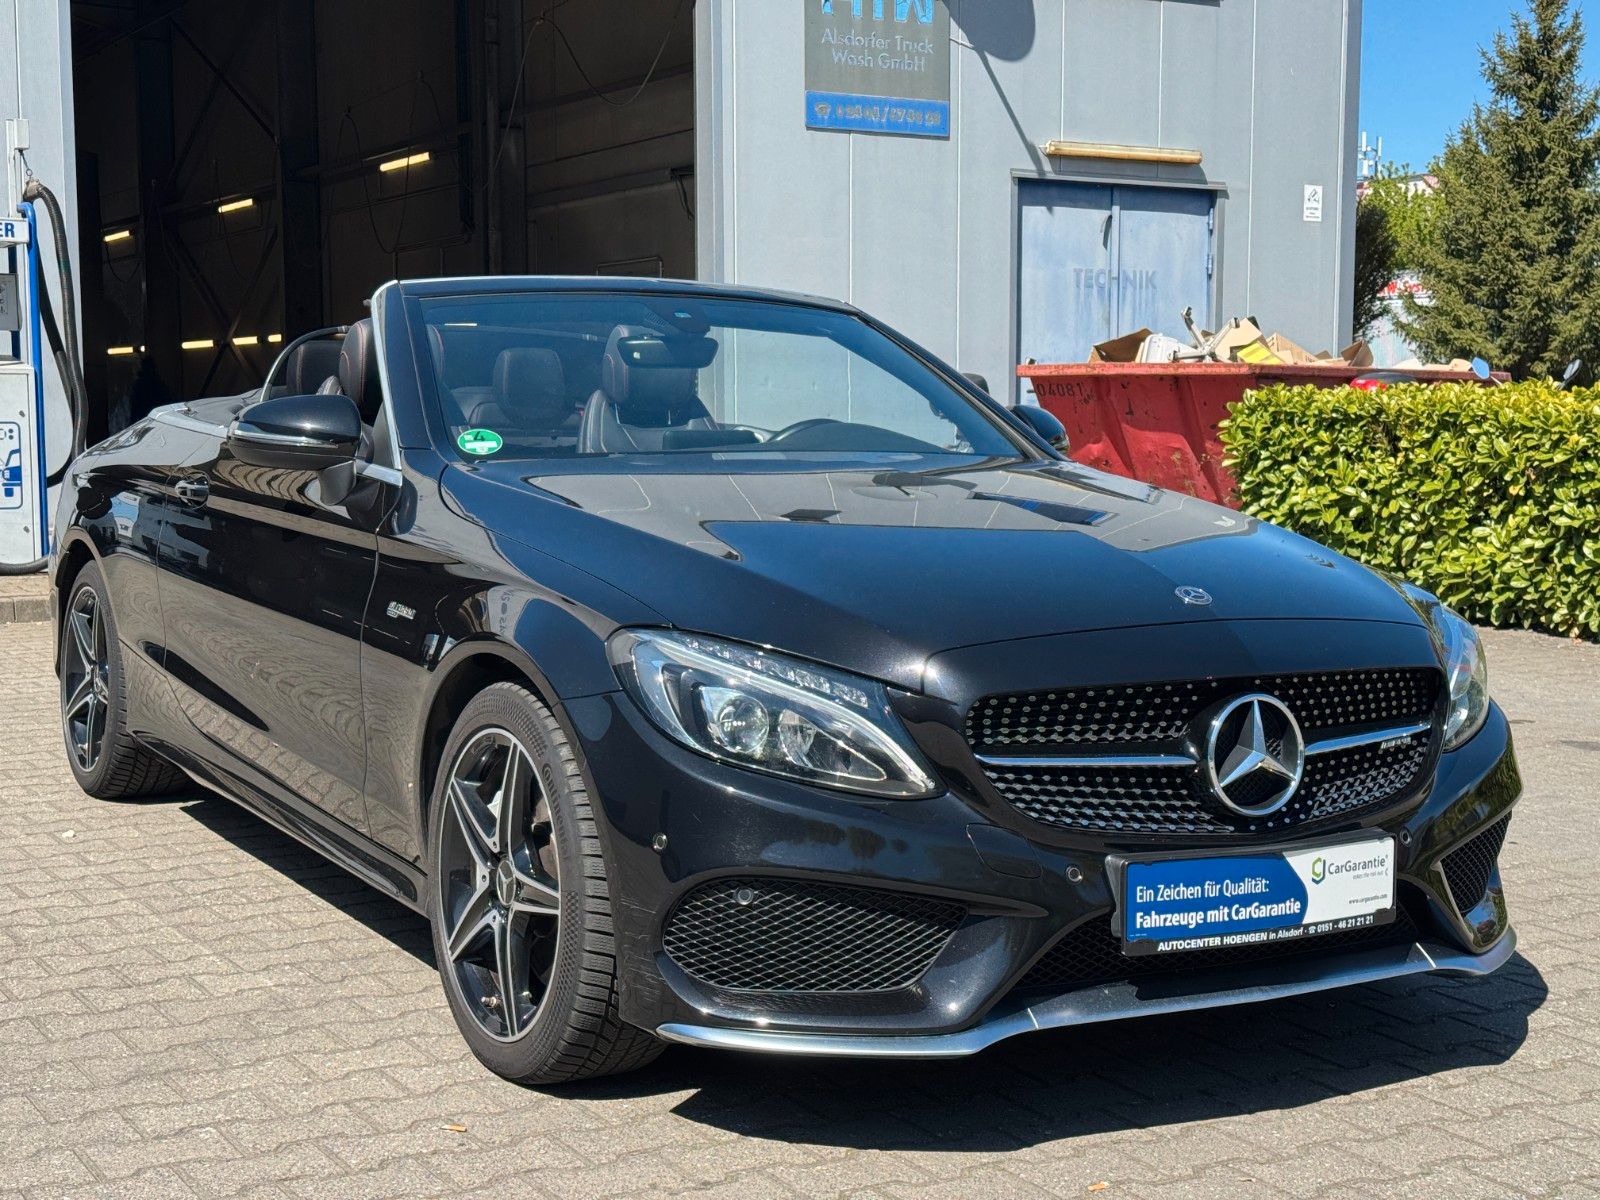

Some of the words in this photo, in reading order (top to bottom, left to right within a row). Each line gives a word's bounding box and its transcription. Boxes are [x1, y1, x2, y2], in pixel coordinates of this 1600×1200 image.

[821, 28, 891, 49] Alsdorfer
[895, 35, 934, 54] Truck
[832, 49, 874, 67] Wash
[878, 53, 926, 72] GmbH
[1073, 268, 1158, 290] TECHNIK
[1036, 382, 1083, 398] 04081
[1136, 886, 1154, 902] Ein
[1157, 882, 1202, 901] Zeichen
[1204, 880, 1221, 898] für
[1223, 877, 1270, 897] Qualität:
[1136, 910, 1205, 928] Fahrzeuge
[1207, 905, 1229, 922] mit
[1231, 898, 1301, 920] CarGarantie
[1157, 937, 1221, 951] AUTOCENTER
[1223, 932, 1267, 945] HOENGEN
[1269, 931, 1276, 940] in
[1277, 926, 1304, 939] Alsdorf
[1317, 922, 1333, 933] 0151
[1338, 919, 1347, 929] 46
[1347, 918, 1355, 928] 21
[1356, 916, 1365, 926] 21
[1365, 915, 1374, 924] 21
